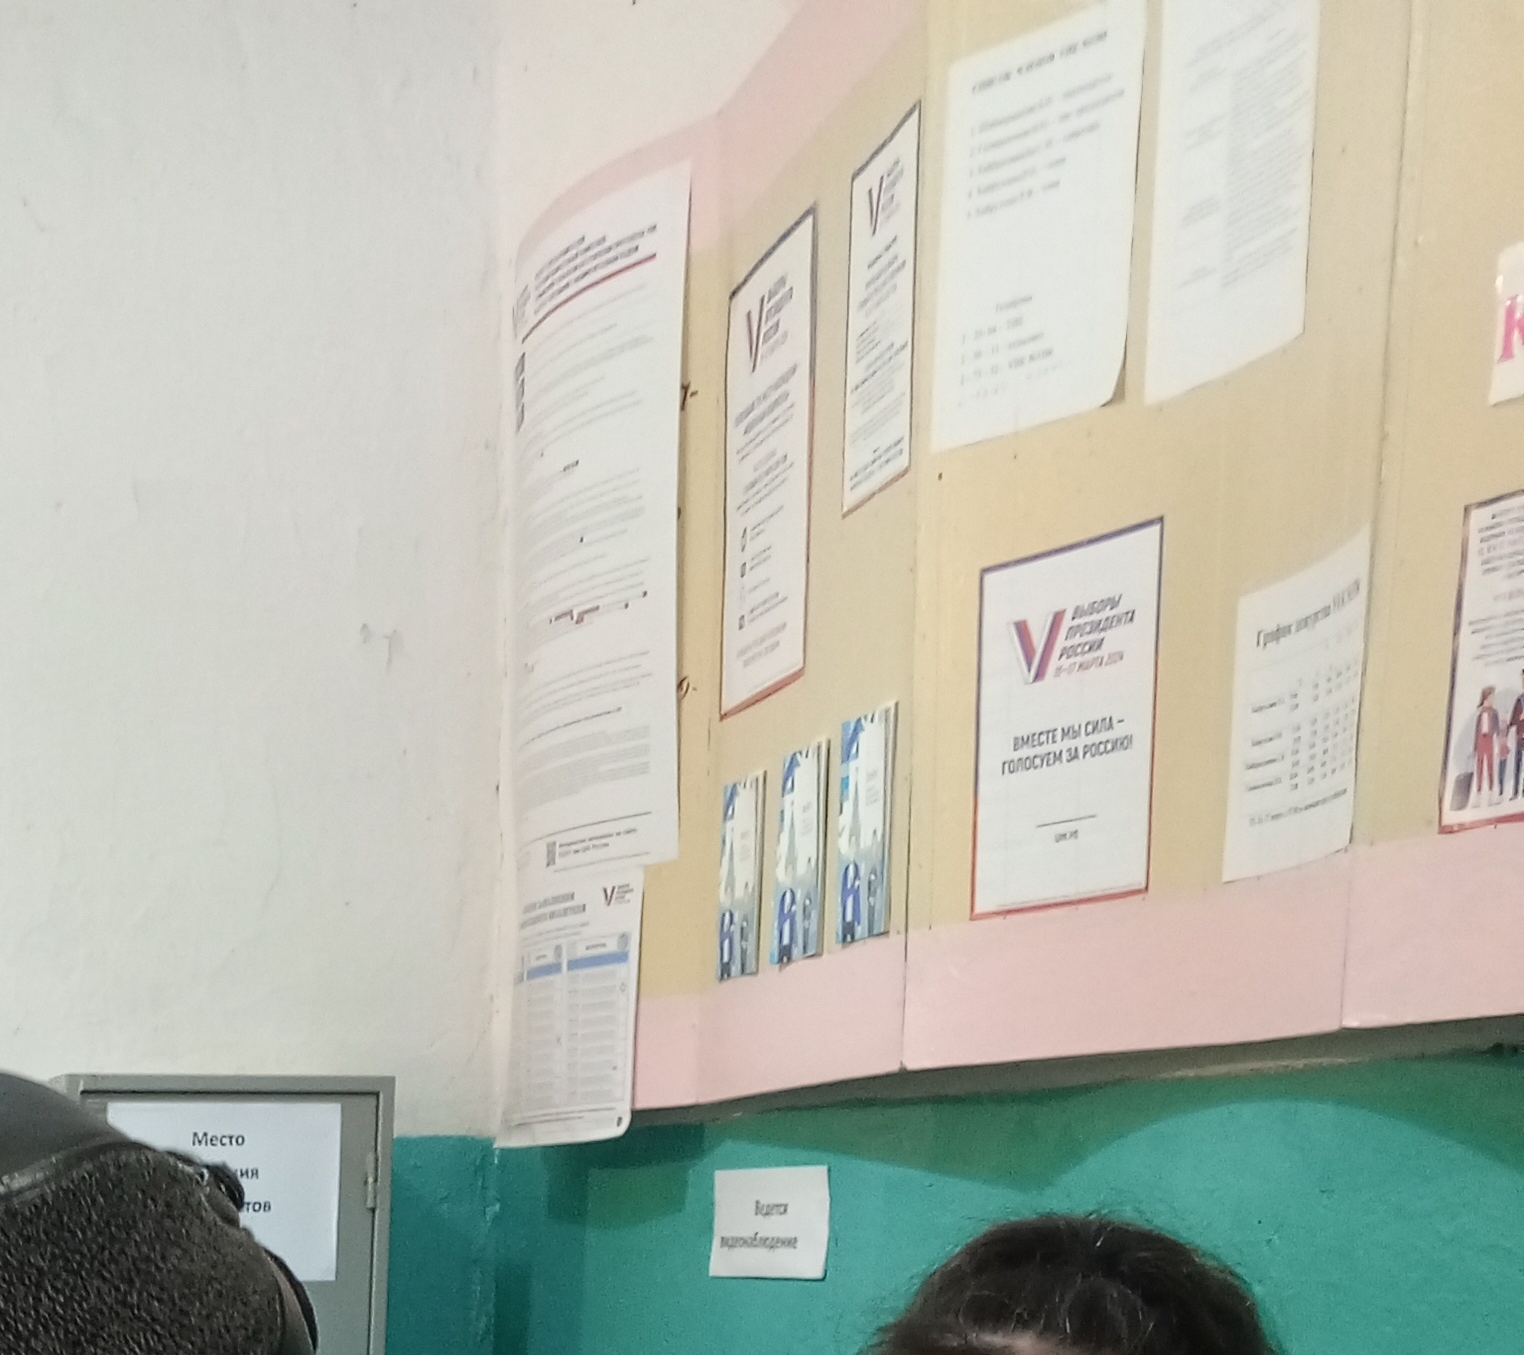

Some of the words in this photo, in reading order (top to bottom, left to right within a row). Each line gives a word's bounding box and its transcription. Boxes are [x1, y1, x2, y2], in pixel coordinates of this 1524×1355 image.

[1071, 594, 1124, 622] ВЫБОРЫ
[1064, 609, 1136, 642] ПРЕЗИДЕНТА
[1058, 636, 1105, 661] РОССИИ
[1077, 655, 1104, 675] МАРТА
[1013, 725, 1059, 752] ВМЕСТЕ
[1060, 723, 1082, 743] МЫ
[1084, 716, 1114, 739] СИЛА
[1001, 749, 1064, 777] ГОЛОСУЕМ
[1065, 746, 1081, 765] ЗА
[1082, 733, 1134, 760] РОССИЮ!
[191, 1131, 246, 1147] Место
[753, 1199, 789, 1218] Ведется
[720, 1231, 799, 1252] видеонаблюдение
